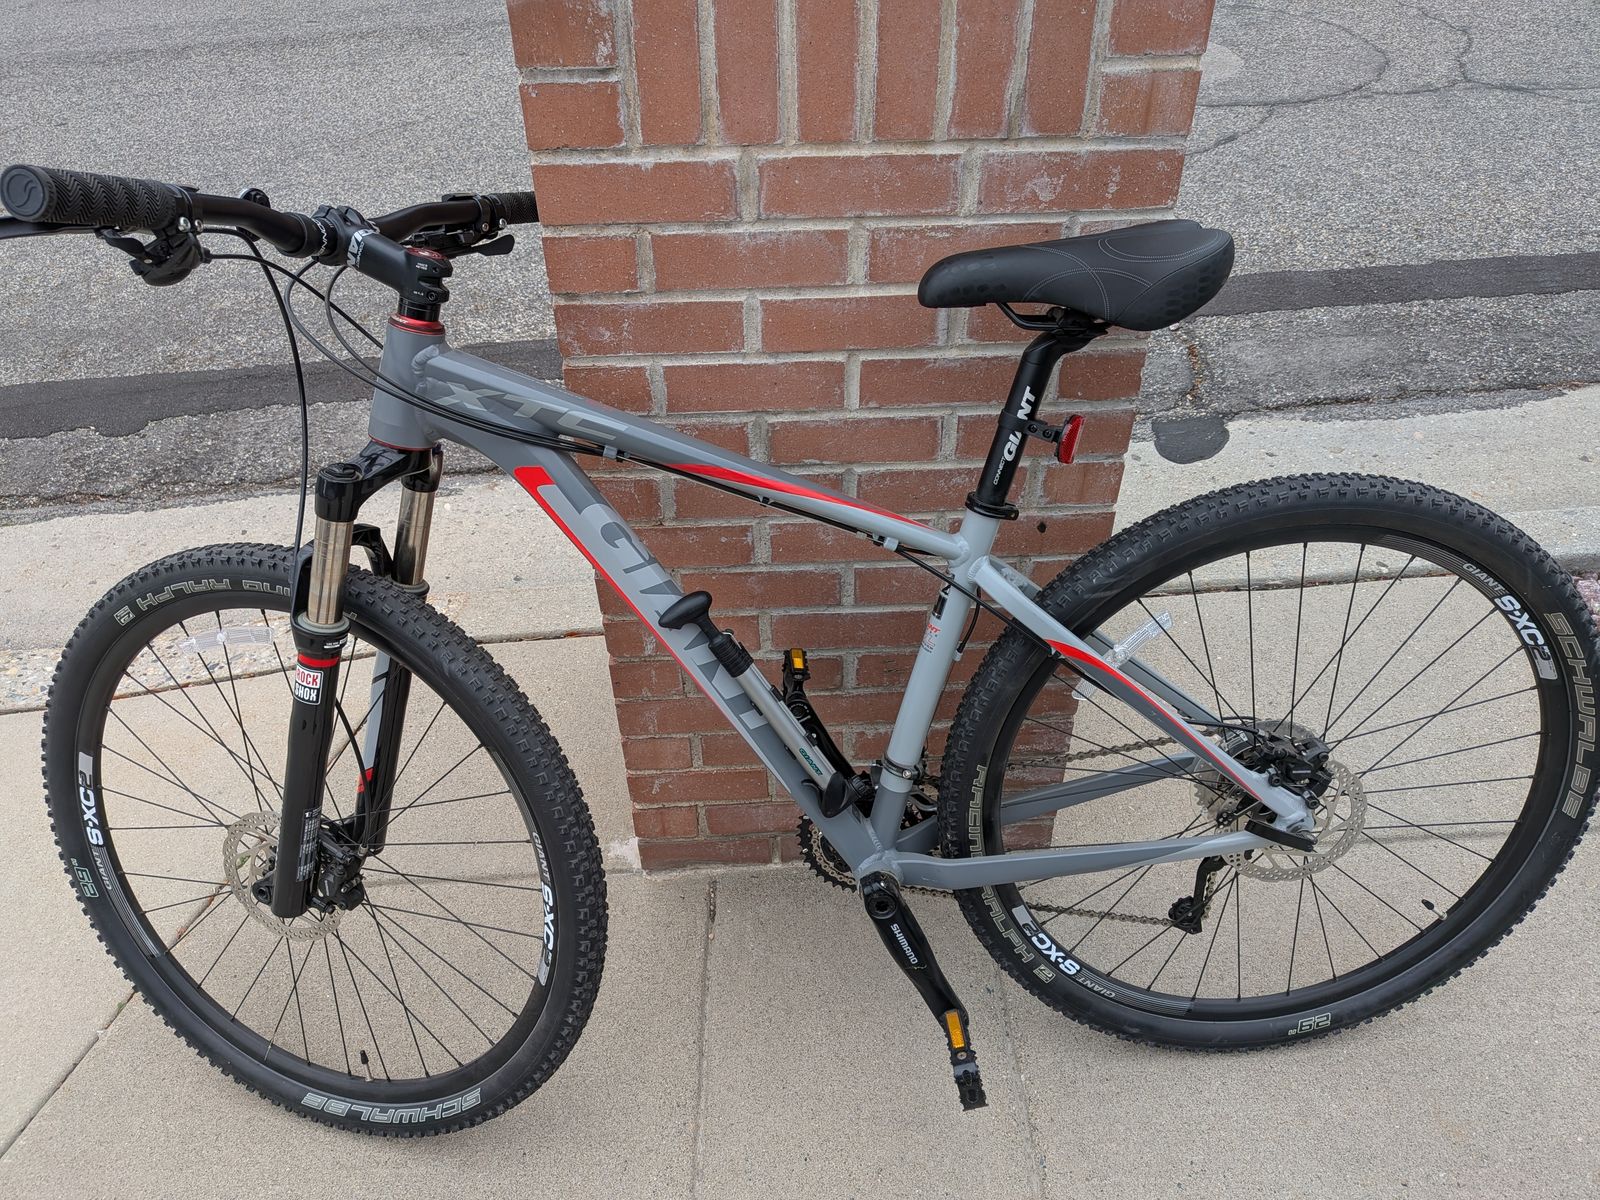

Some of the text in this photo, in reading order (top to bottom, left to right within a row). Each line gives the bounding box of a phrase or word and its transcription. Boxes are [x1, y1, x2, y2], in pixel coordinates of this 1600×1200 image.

[136, 578, 231, 612] RALPH
[1462, 562, 1505, 594] GIANT
[294, 683, 318, 702] SHOX
[296, 668, 320, 687] ROCK
[1543, 612, 1597, 819] SCHWALBE
[799, 747, 824, 776] GIANT
[92, 847, 112, 891] GIANT
[532, 831, 551, 881] GIANT
[890, 923, 919, 965] SHIMANO
[1076, 977, 1117, 999] GIANT
[300, 1087, 481, 1124] SCHWALBE
